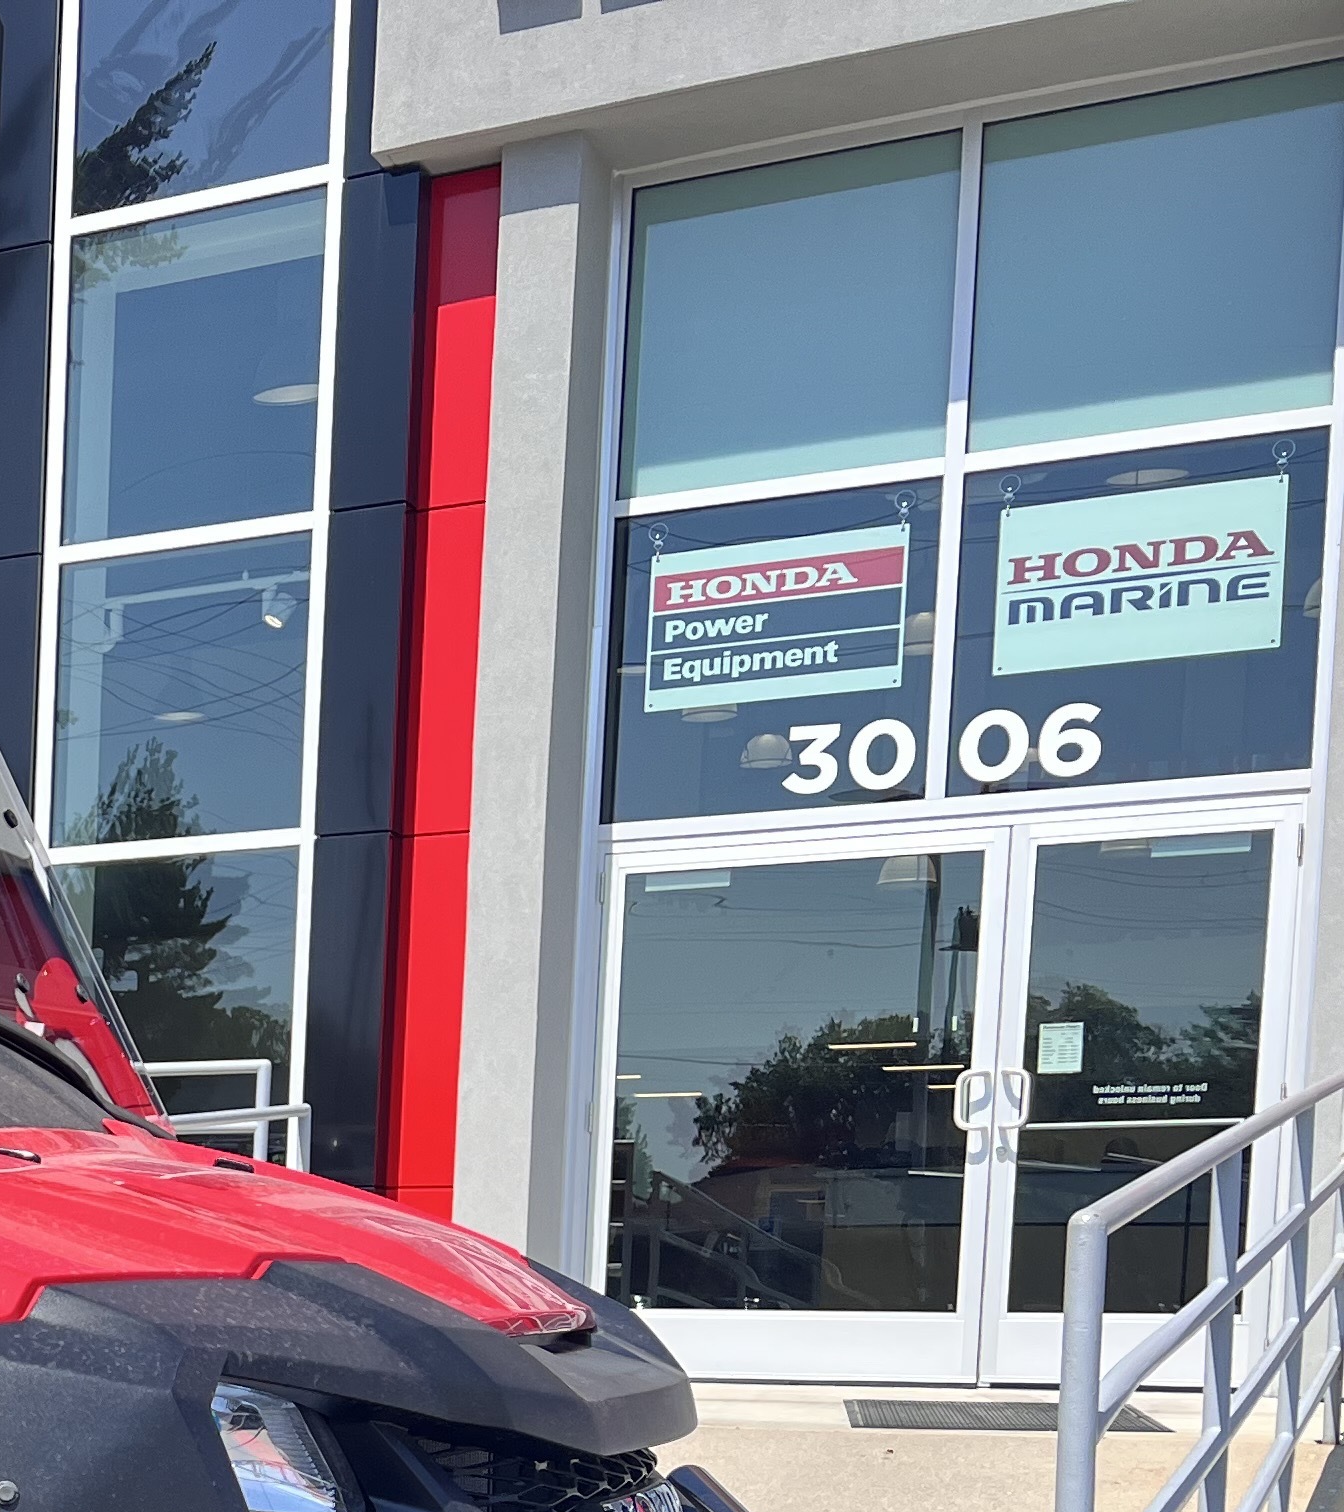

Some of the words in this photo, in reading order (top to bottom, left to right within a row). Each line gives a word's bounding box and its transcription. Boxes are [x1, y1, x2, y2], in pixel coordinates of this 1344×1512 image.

[1007, 528, 1276, 586] HONDA
[665, 561, 859, 605] HONDA
[1007, 570, 1272, 626] MARINE
[664, 612, 769, 643] Power
[662, 640, 839, 682] Equipment
